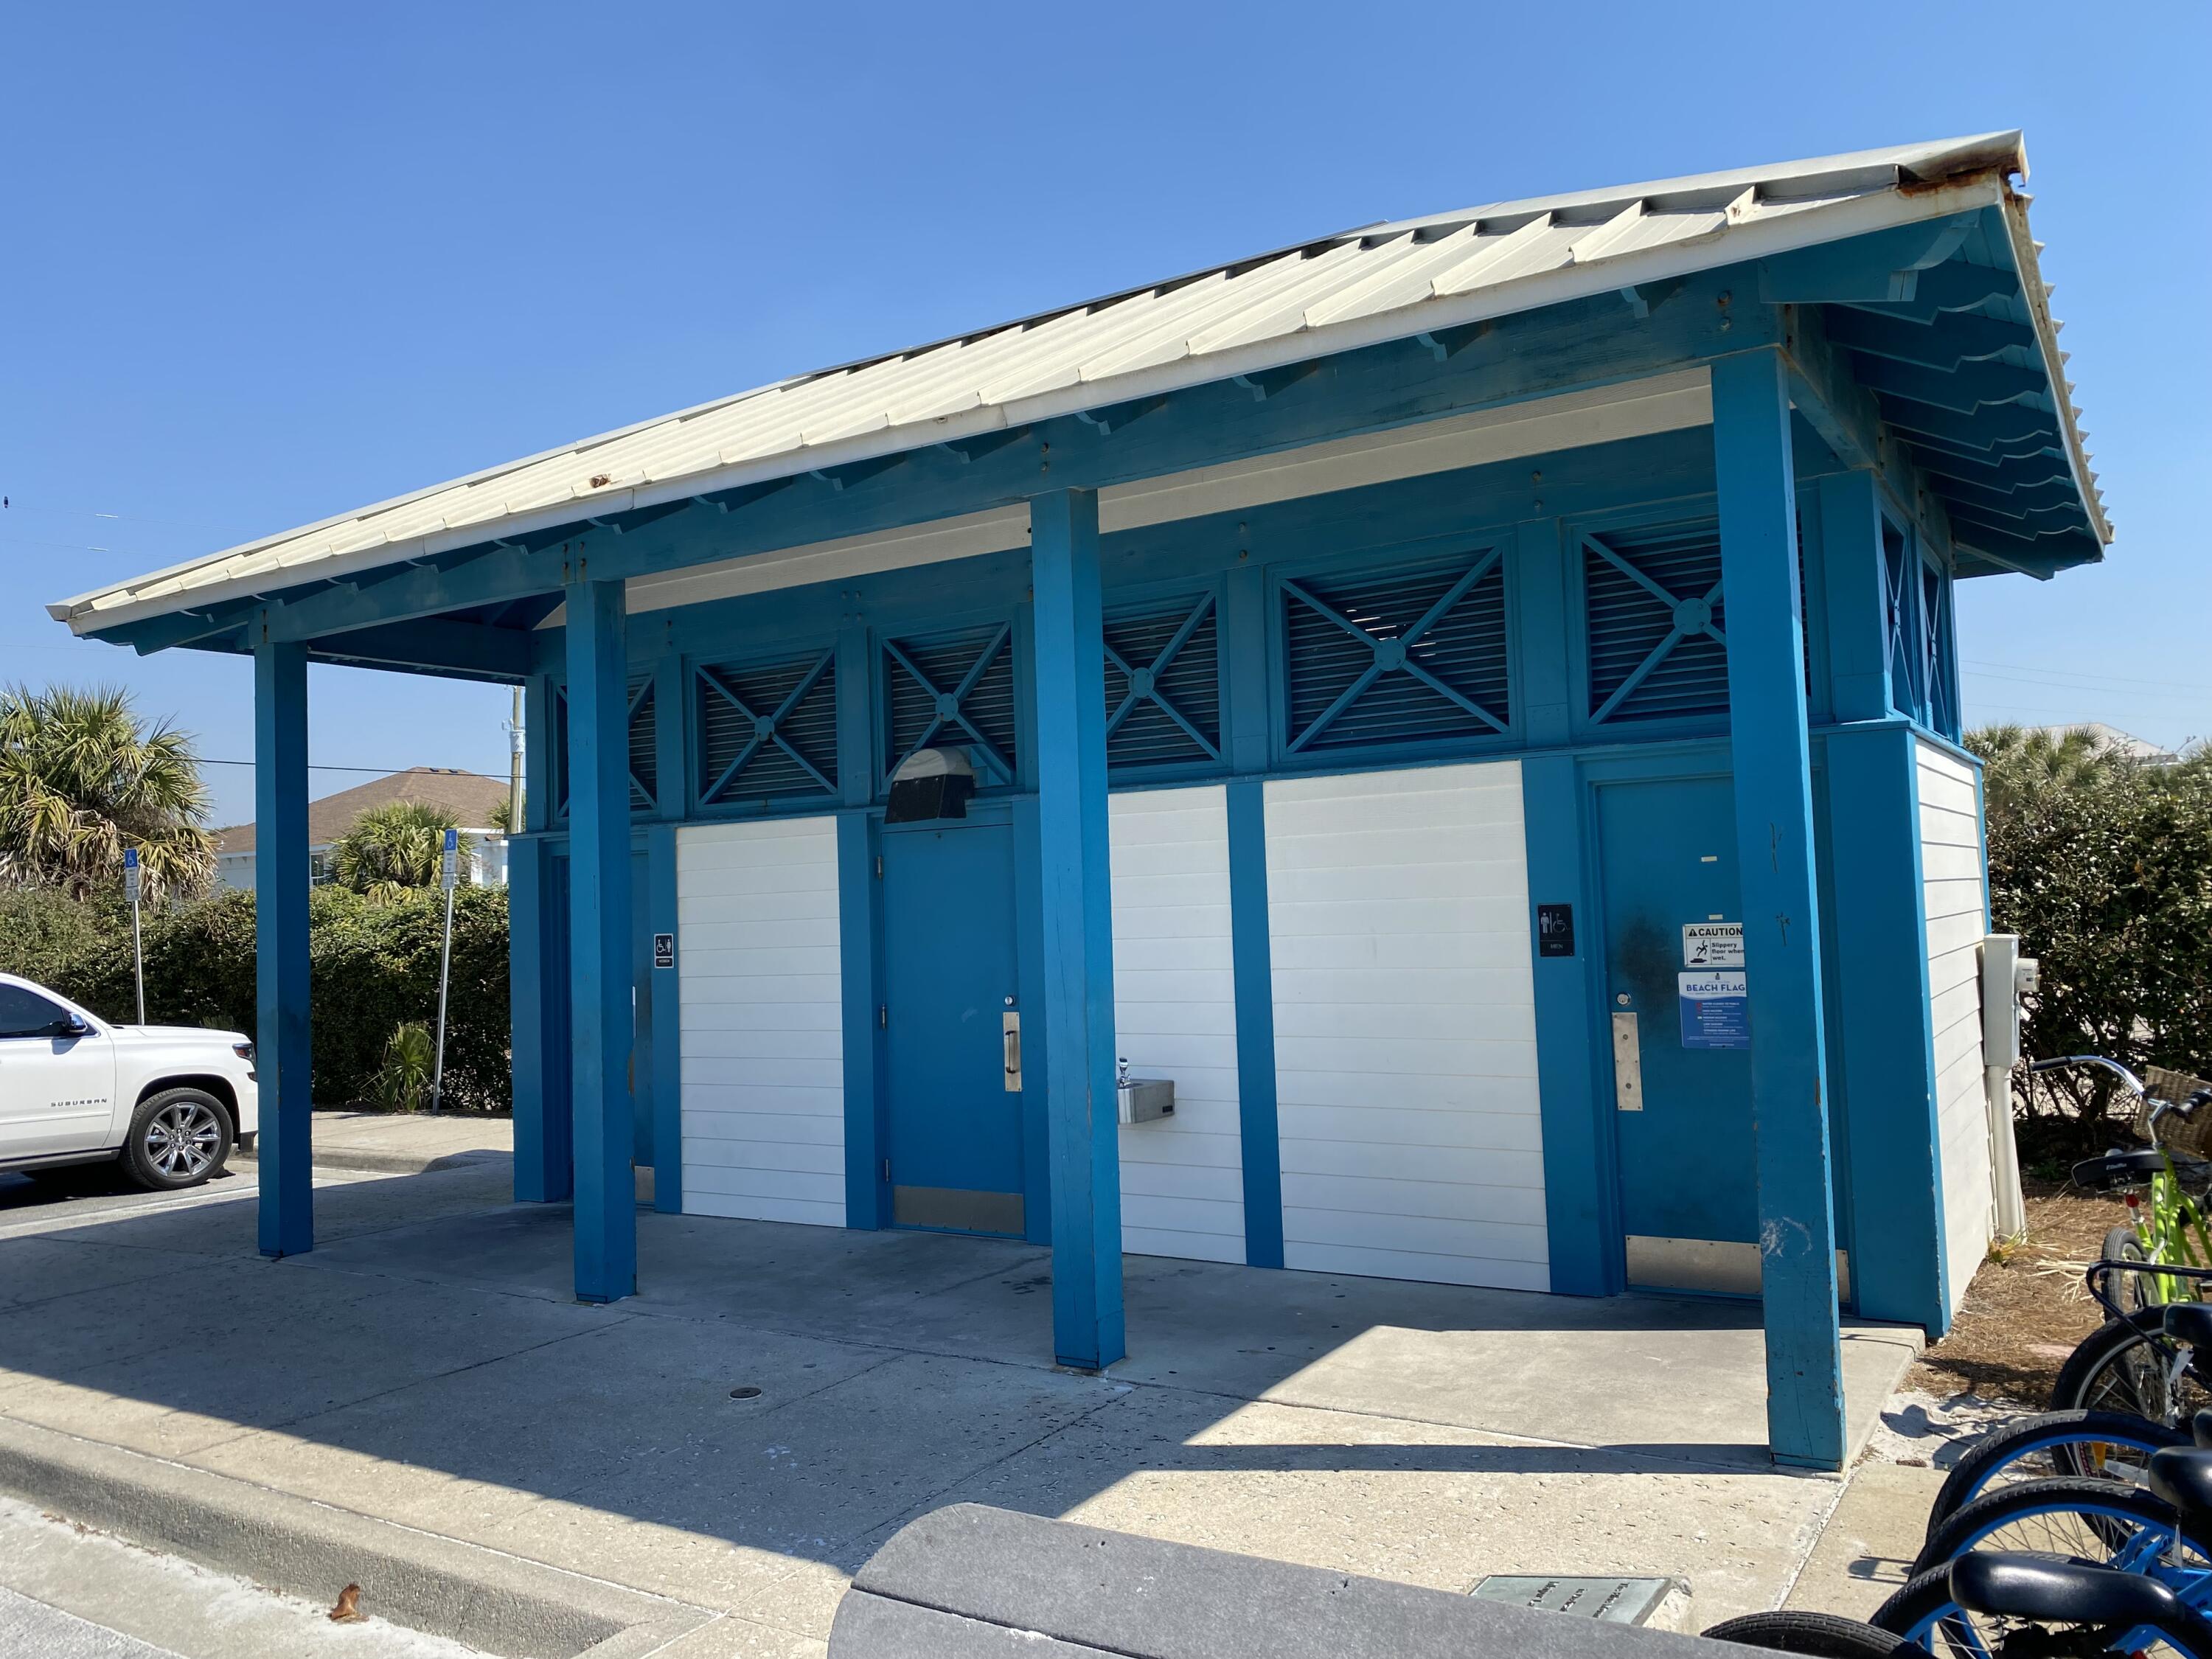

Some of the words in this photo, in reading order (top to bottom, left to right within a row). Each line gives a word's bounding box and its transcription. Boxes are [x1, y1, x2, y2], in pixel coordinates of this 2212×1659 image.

[1698, 927, 1743, 936] CAUTION
[1686, 984, 1718, 992] BEACH
[50, 1098, 107, 1107] SUBURBAN
